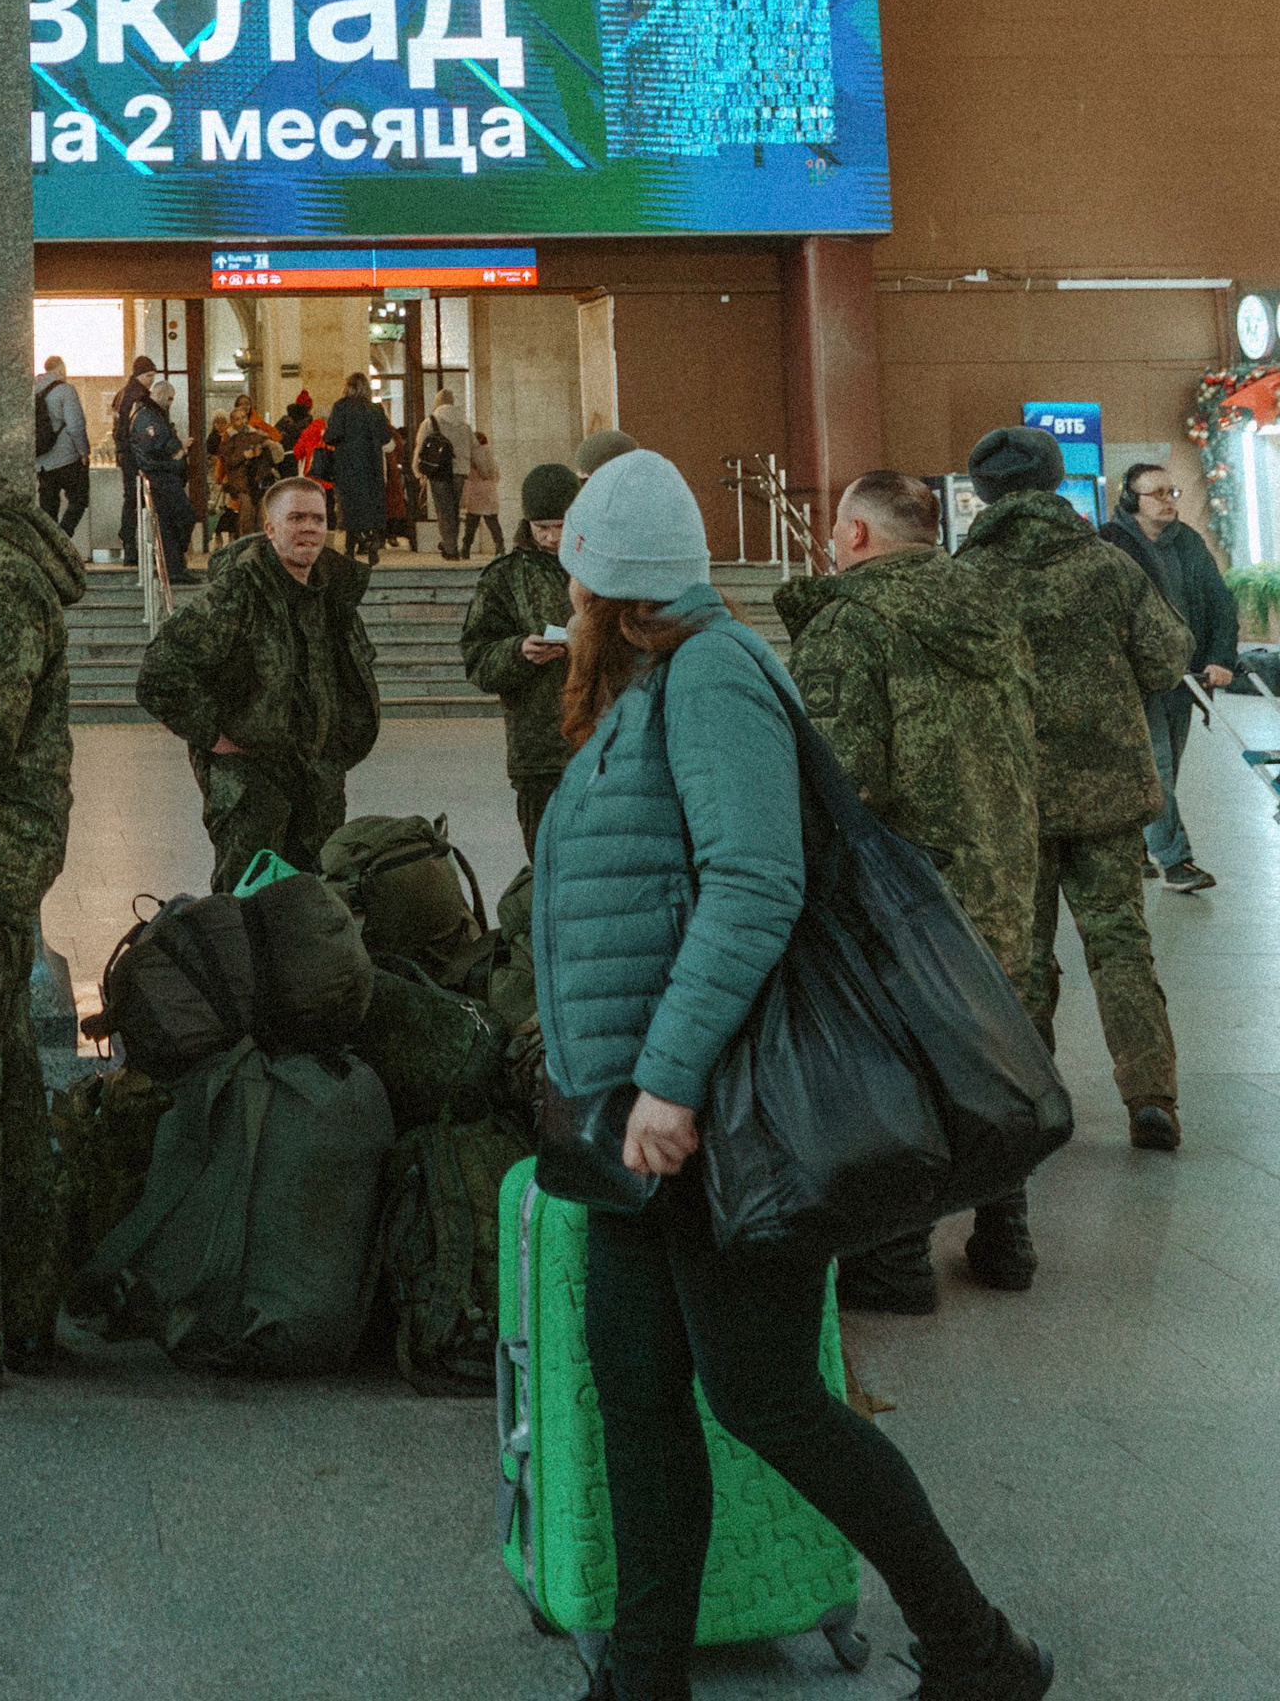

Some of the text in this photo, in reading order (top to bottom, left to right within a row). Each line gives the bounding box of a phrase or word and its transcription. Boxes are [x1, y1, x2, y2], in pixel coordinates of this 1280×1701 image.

[123, 93, 174, 162] 2
[200, 105, 526, 174] месяца
[1053, 417, 1087, 435] ВТБ
